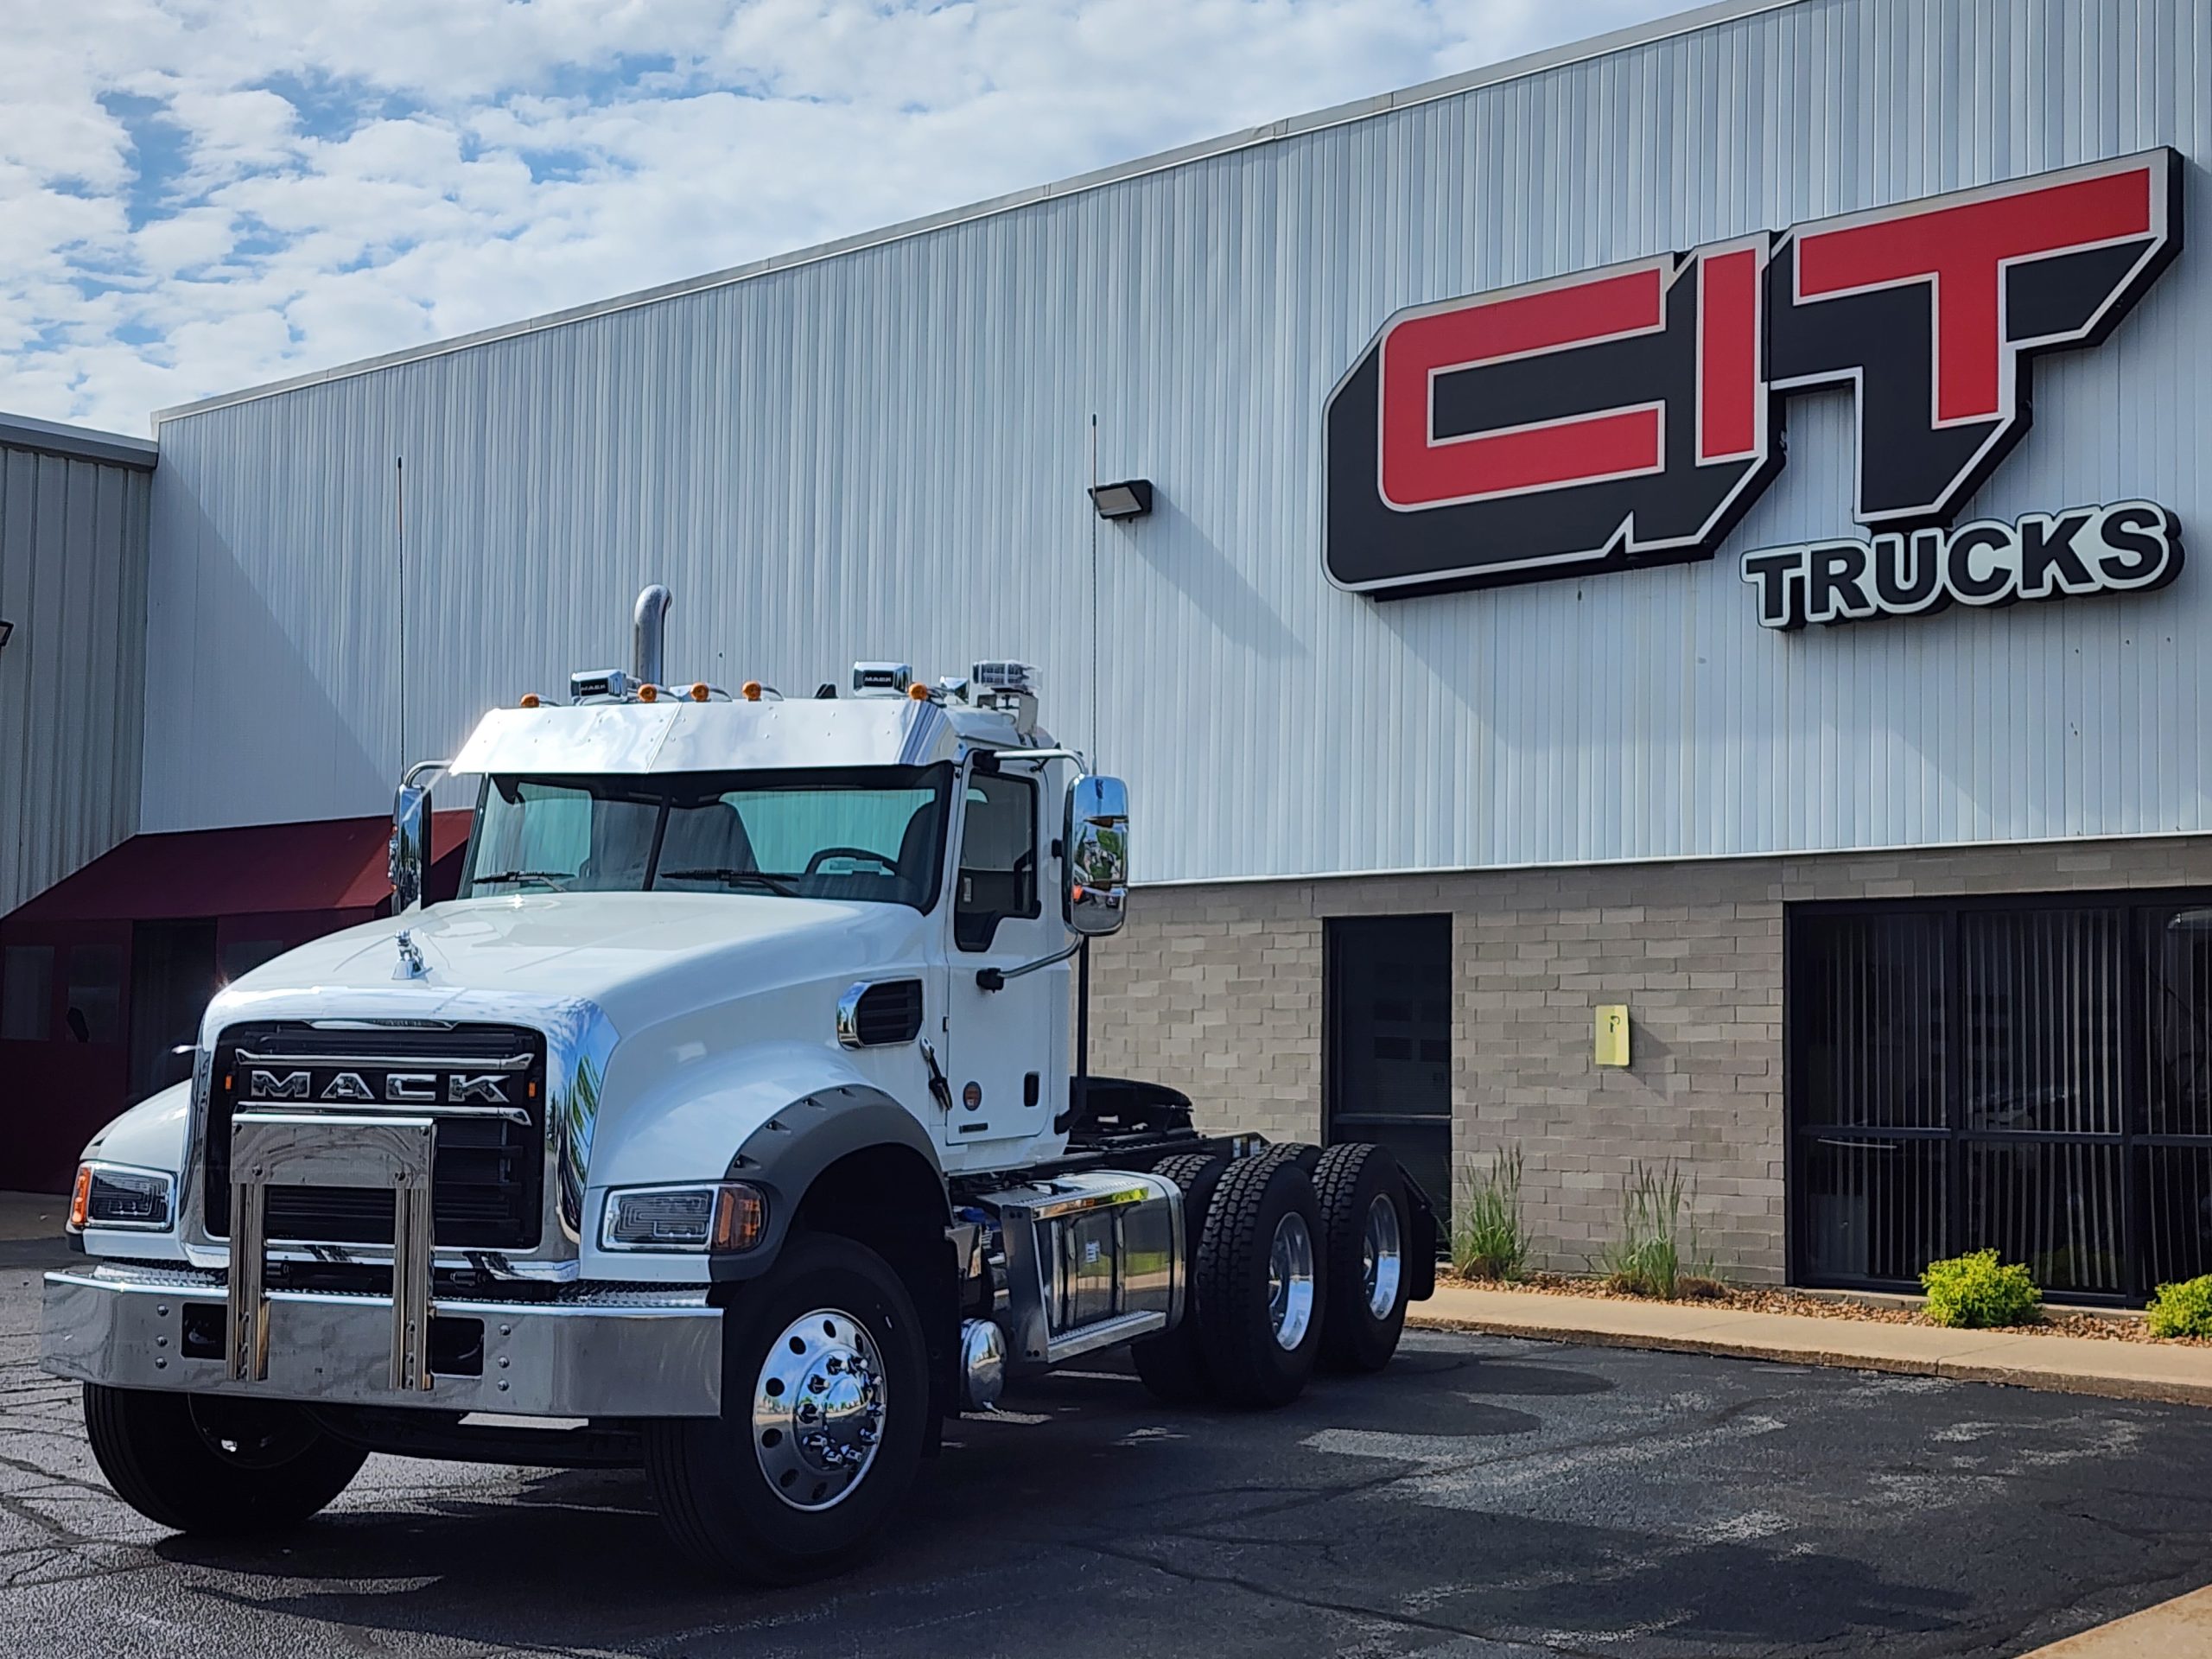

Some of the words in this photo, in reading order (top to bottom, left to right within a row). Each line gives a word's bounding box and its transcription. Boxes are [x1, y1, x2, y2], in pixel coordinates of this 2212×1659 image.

[1376, 152, 2167, 513] CIT
[1745, 508, 2164, 620] TRUCKS
[251, 1070, 511, 1103] MACK
